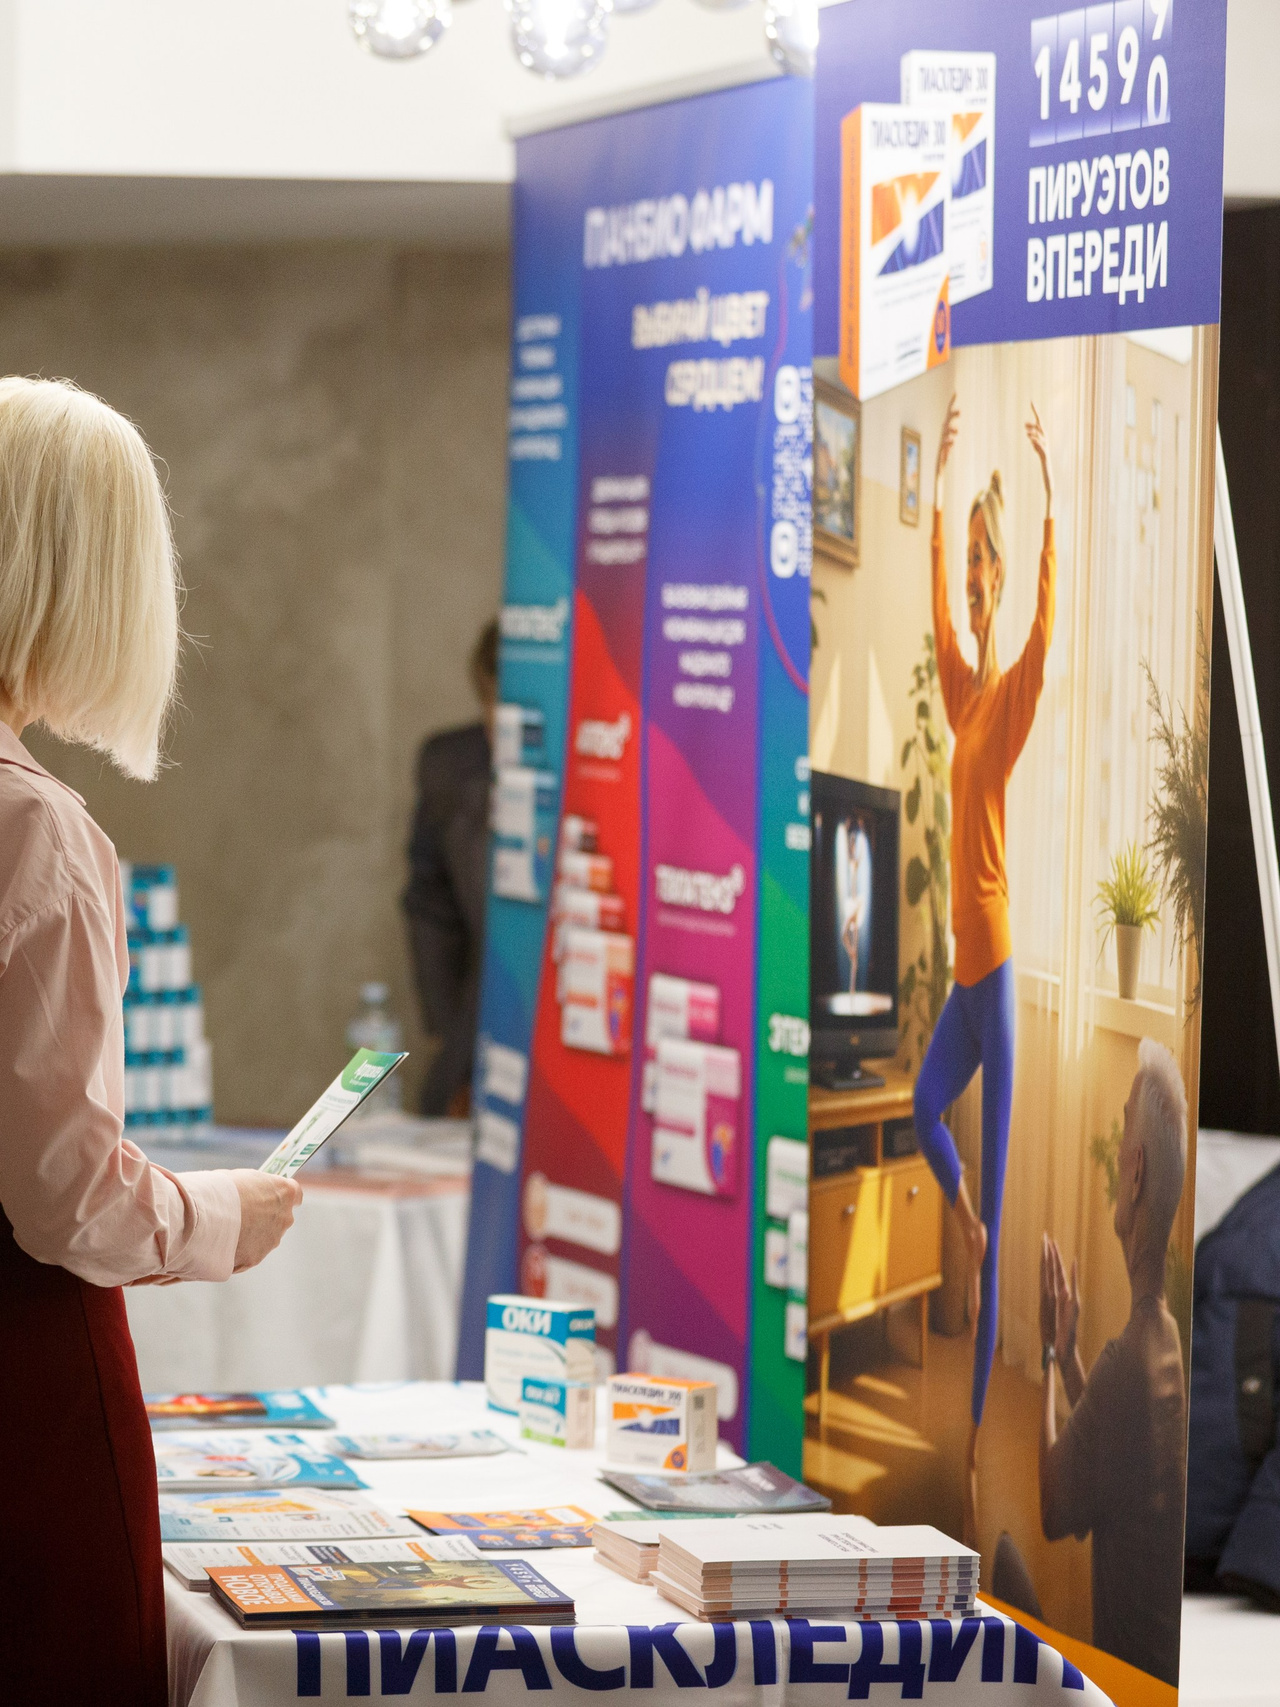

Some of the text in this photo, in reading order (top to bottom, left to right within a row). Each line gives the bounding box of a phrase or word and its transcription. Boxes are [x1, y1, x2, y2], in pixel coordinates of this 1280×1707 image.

[1028, 147, 1170, 224] ПИРУЭТОВ
[1027, 221, 1168, 305] ВПЕРЕДИ
[501, 1305, 552, 1336] ОКИ
[218, 1574, 272, 1606] НОВОЕ
